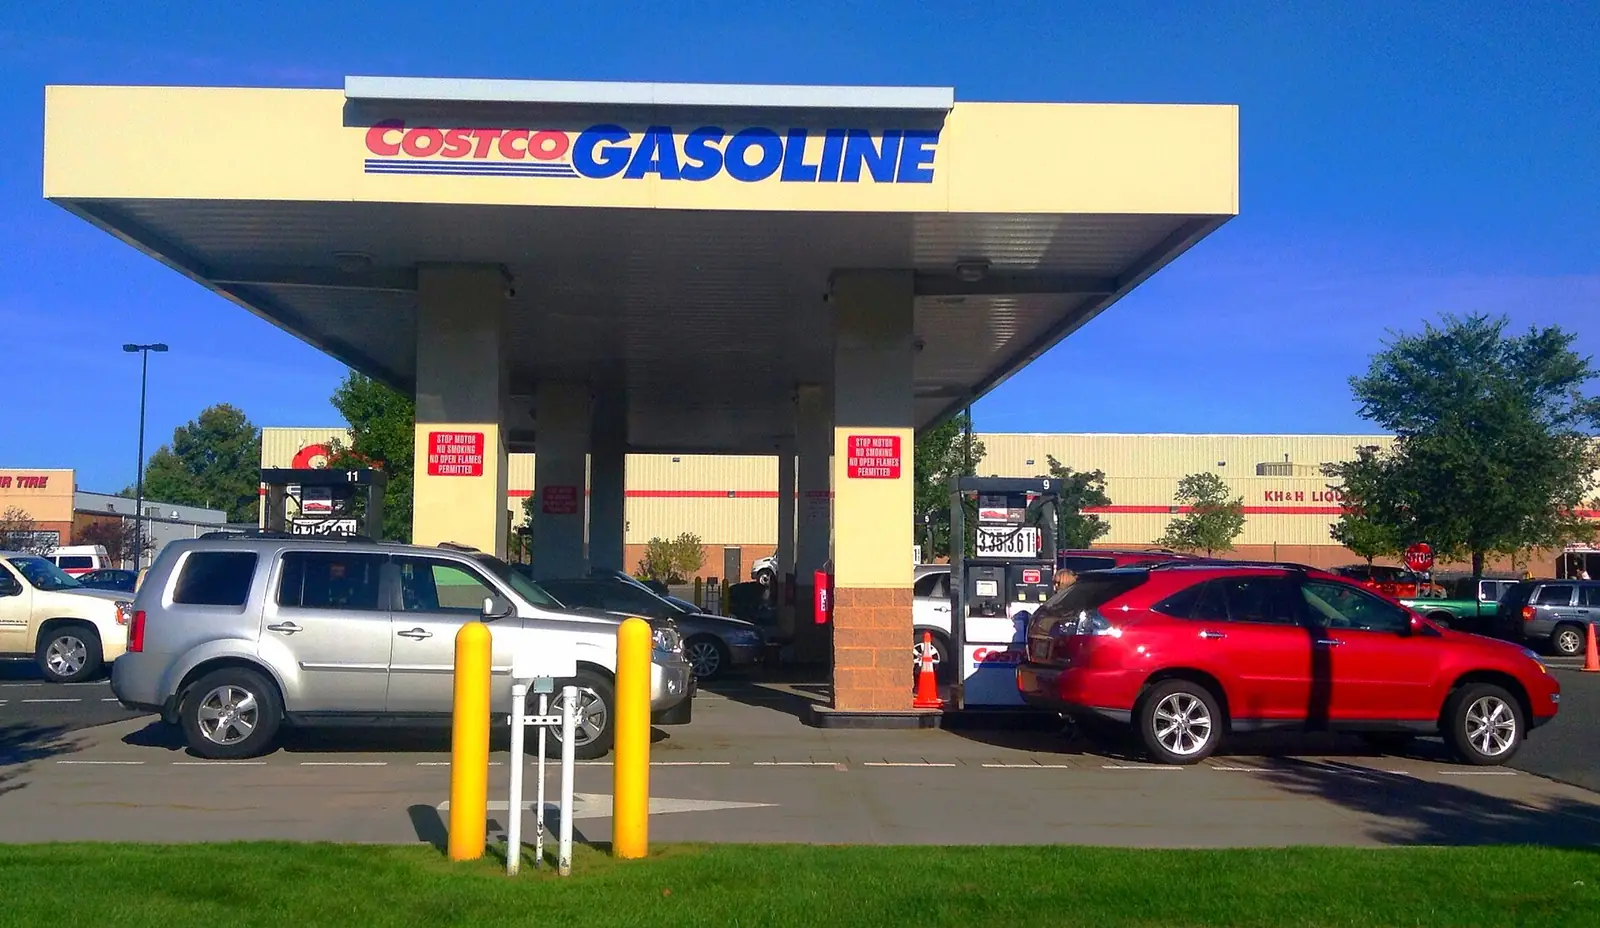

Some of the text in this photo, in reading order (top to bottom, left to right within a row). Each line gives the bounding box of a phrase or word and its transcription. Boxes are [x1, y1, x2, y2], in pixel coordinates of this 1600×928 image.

[365, 119, 940, 184] COSTCO GASOLINE
[436, 434, 476, 444] STOP MOTOR
[855, 437, 893, 448] STOP MOTOR
[436, 444, 476, 454] NO SMOKING
[855, 447, 893, 457] NO SMOKING
[429, 454, 482, 465] NO OPEN FLAMES
[849, 457, 900, 467] NO OPEN FLAMES
[438, 464, 473, 474] PERMITTED
[857, 467, 891, 477] PERMITTED
[346, 471, 358, 482] 11
[16, 476, 48, 488] TIRE
[1043, 480, 1050, 490] 9
[1407, 551, 1432, 564] STOP
